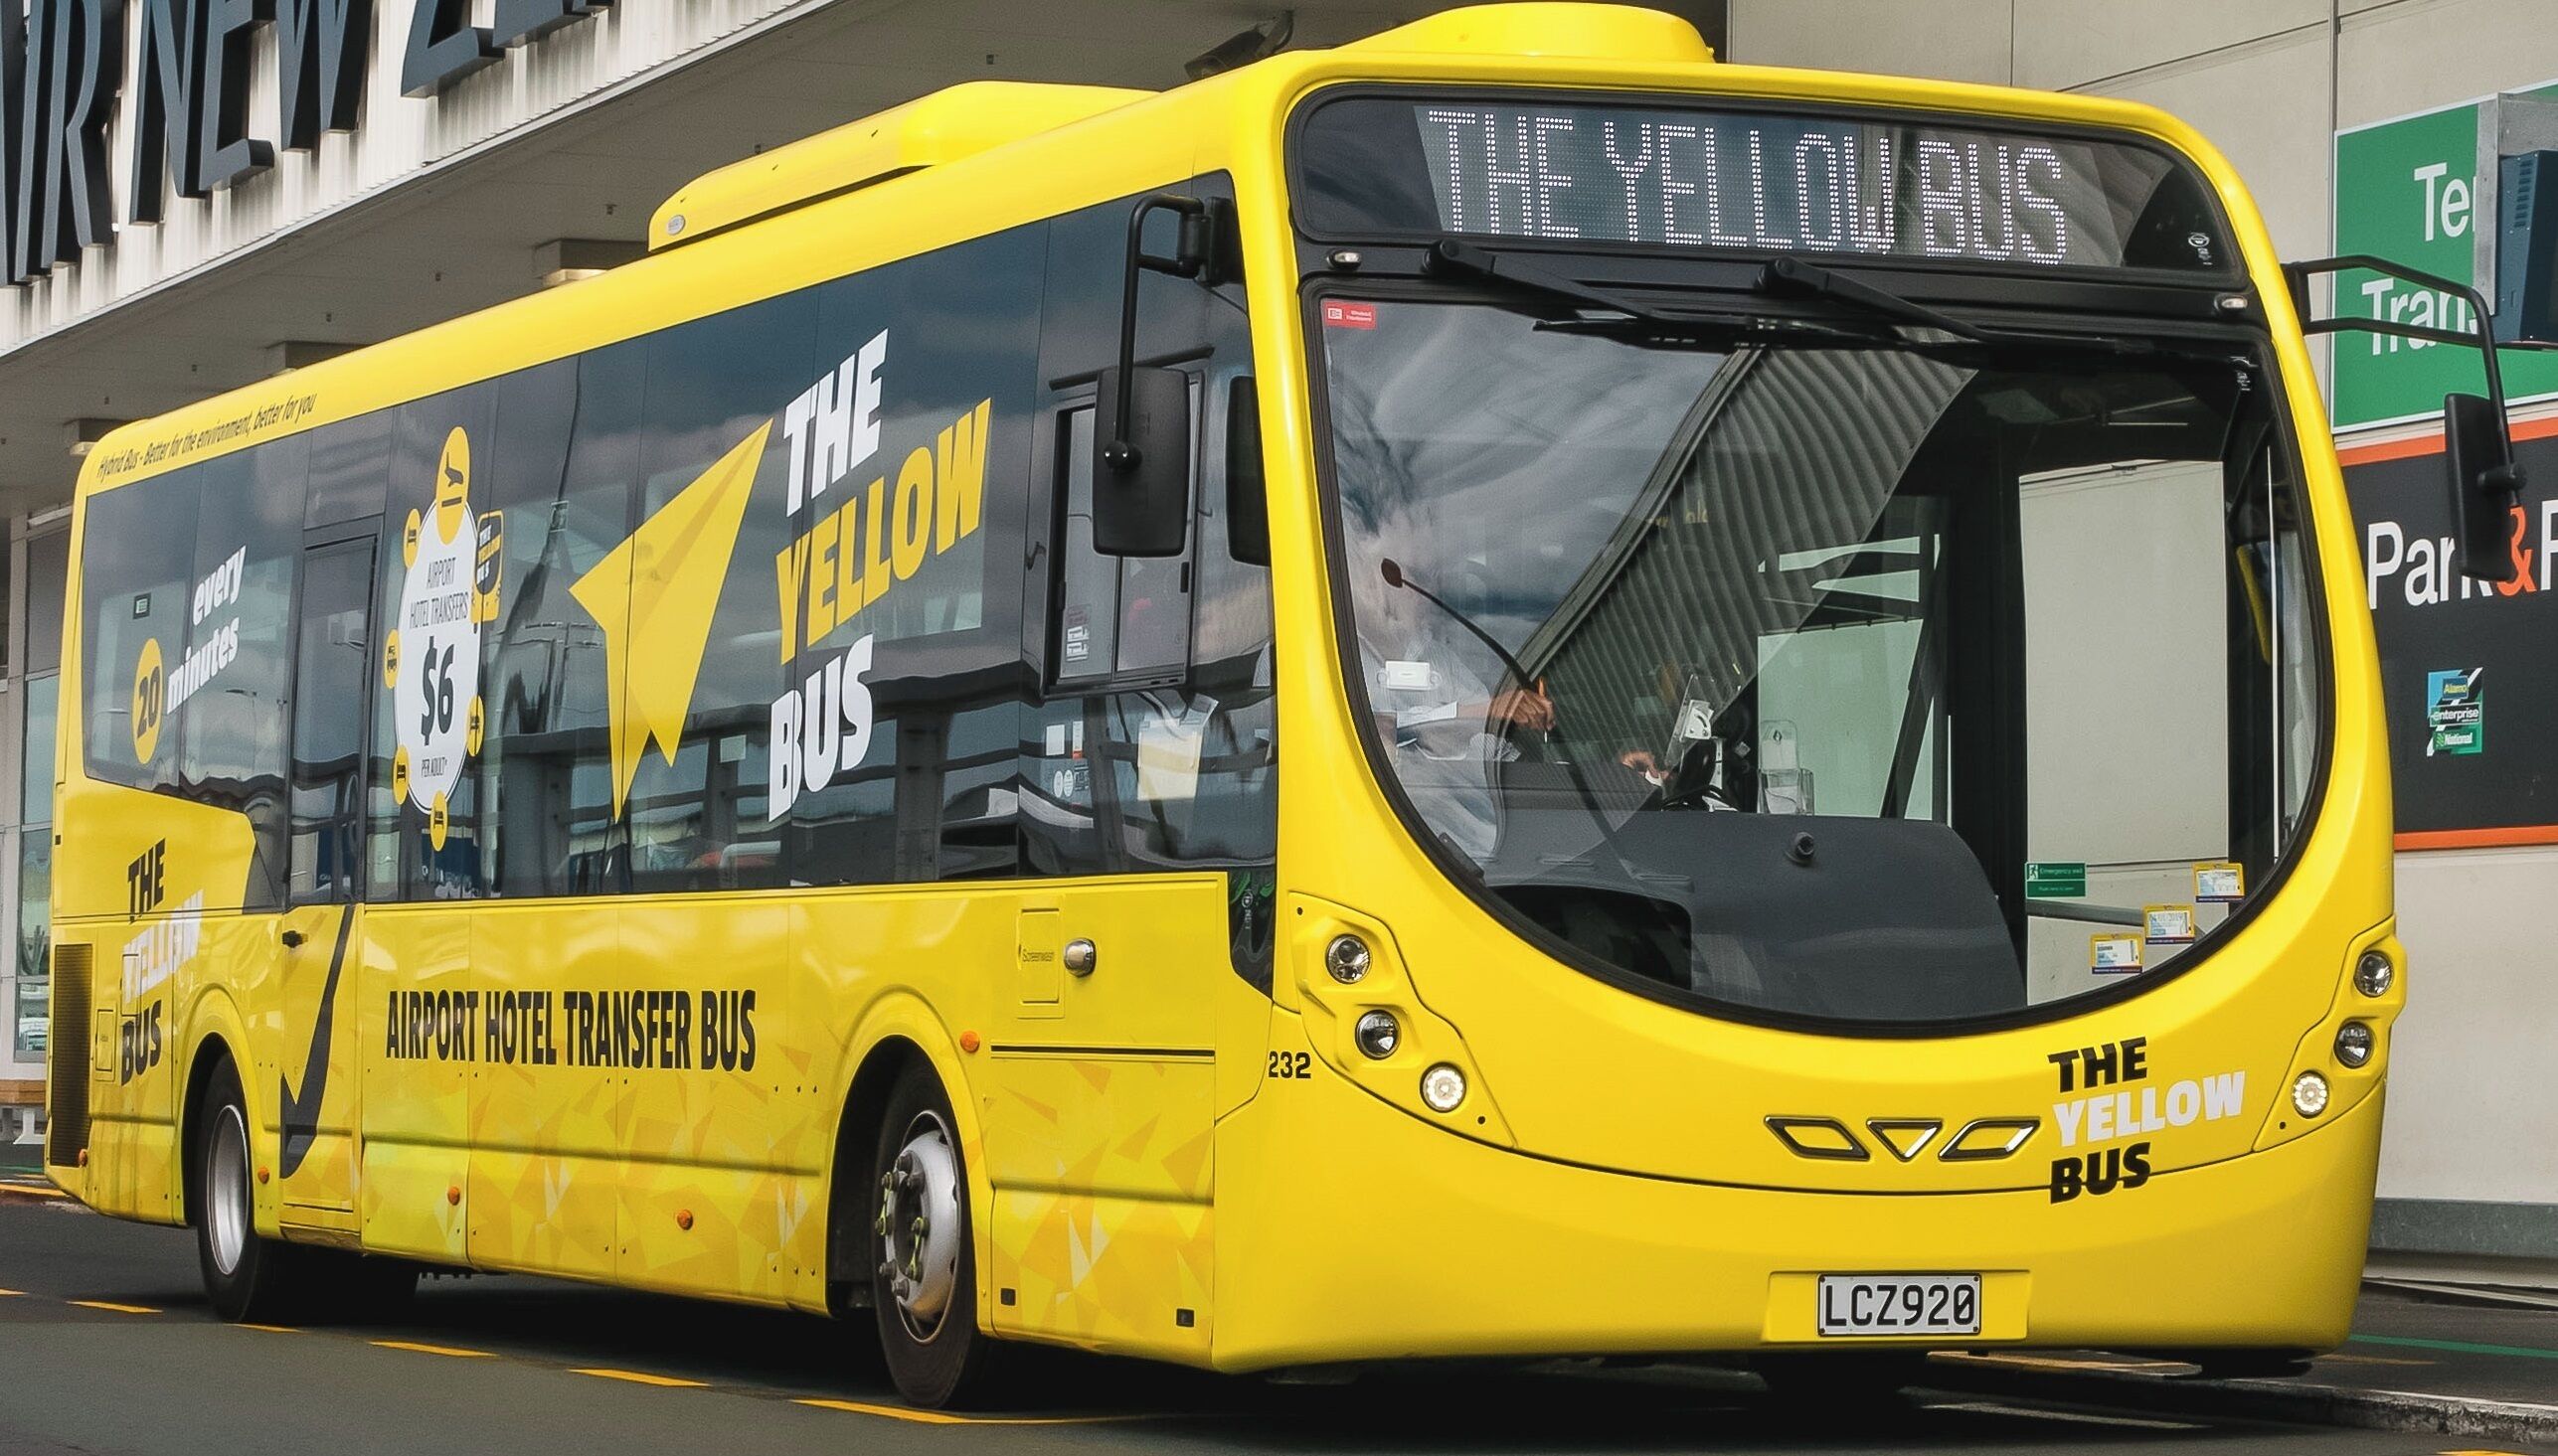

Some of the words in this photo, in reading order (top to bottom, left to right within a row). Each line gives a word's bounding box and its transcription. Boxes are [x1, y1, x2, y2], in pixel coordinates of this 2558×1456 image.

[1429, 110, 1579, 239] THE
[1605, 121, 1894, 255] YELLOW
[1920, 141, 2067, 265] BUS
[123, 448, 138, 471] Bus
[143, 440, 171, 465] Better
[167, 434, 181, 458] for
[182, 428, 197, 453] the
[253, 406, 284, 430] better
[281, 396, 298, 420] for
[294, 394, 317, 424] you
[783, 328, 888, 517] THE
[775, 398, 991, 665] YELLOW
[193, 545, 247, 626] every
[410, 598, 429, 629] HOTEL
[430, 591, 469, 626] TRANSFERS
[426, 557, 456, 589] AIRPORT
[137, 666, 160, 738] 20
[166, 617, 240, 715] minutes
[422, 636, 454, 745] $6
[768, 634, 873, 822] BUS
[127, 838, 166, 924] THE
[121, 1000, 162, 1086] BUS
[386, 989, 478, 1061] AIRPORT
[485, 990, 557, 1065] HOTEL
[563, 990, 692, 1070] TRANSFER
[701, 989, 756, 1071] BUS
[1269, 1051, 1311, 1078] 232
[2047, 1037, 2147, 1093] THE
[2052, 1070, 2246, 1147] YELLOW
[2050, 1142, 2151, 1205] BUS
[1824, 1284, 1975, 1326] LCZ920
